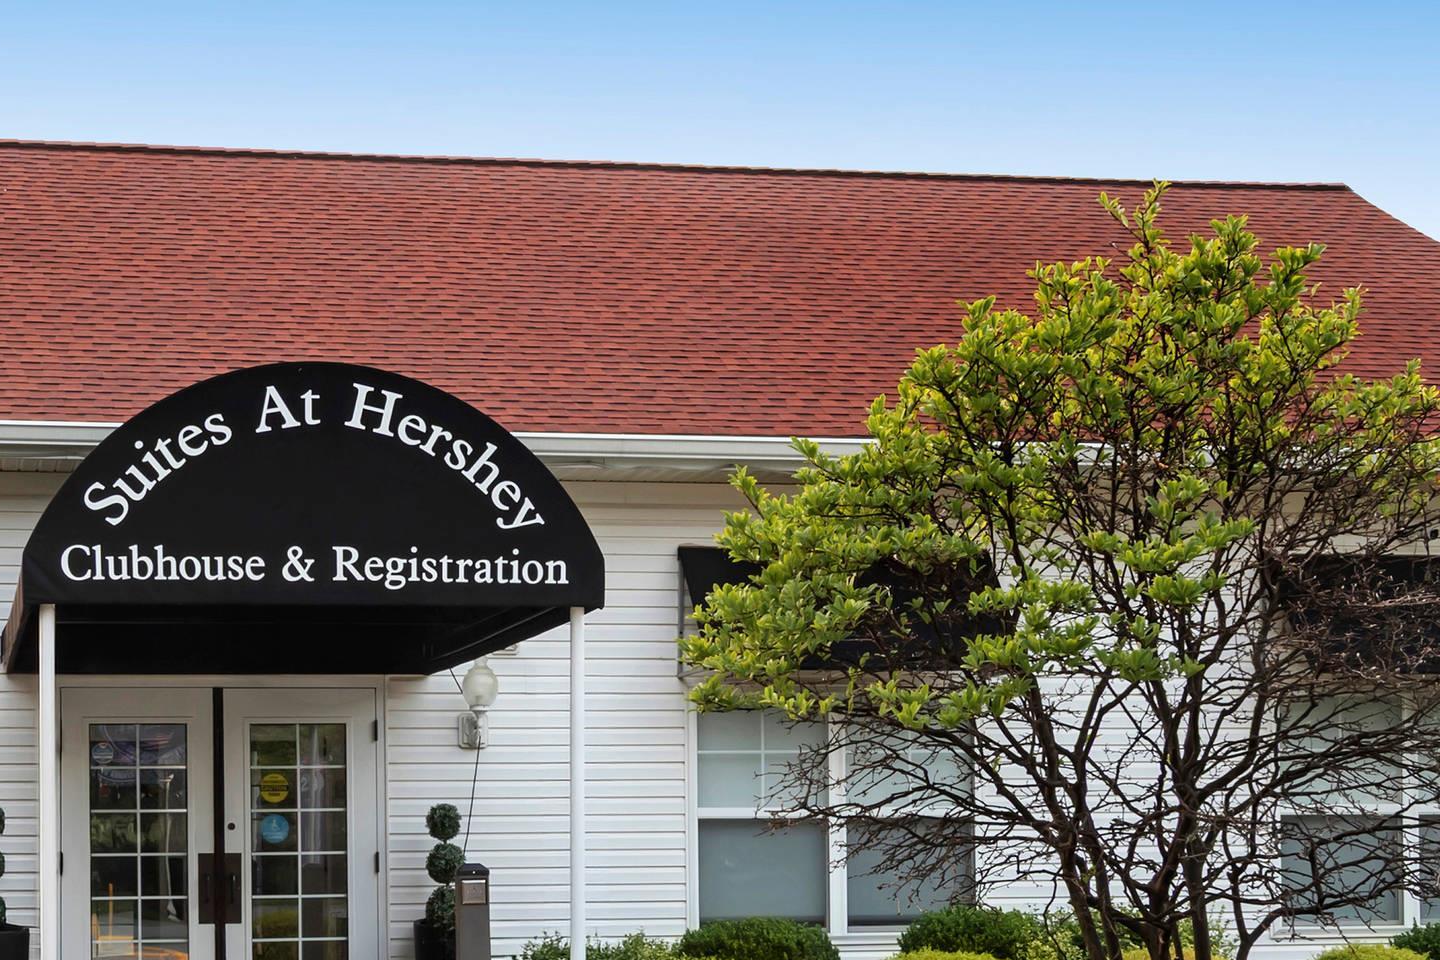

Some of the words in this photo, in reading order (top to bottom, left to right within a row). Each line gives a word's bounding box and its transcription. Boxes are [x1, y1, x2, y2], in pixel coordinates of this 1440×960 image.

[83, 413, 233, 526] Suites
[255, 385, 321, 434] At
[344, 382, 545, 531] Hershey
[60, 544, 266, 582] Clubhouse
[281, 545, 315, 582] &
[332, 545, 569, 590] Registration
